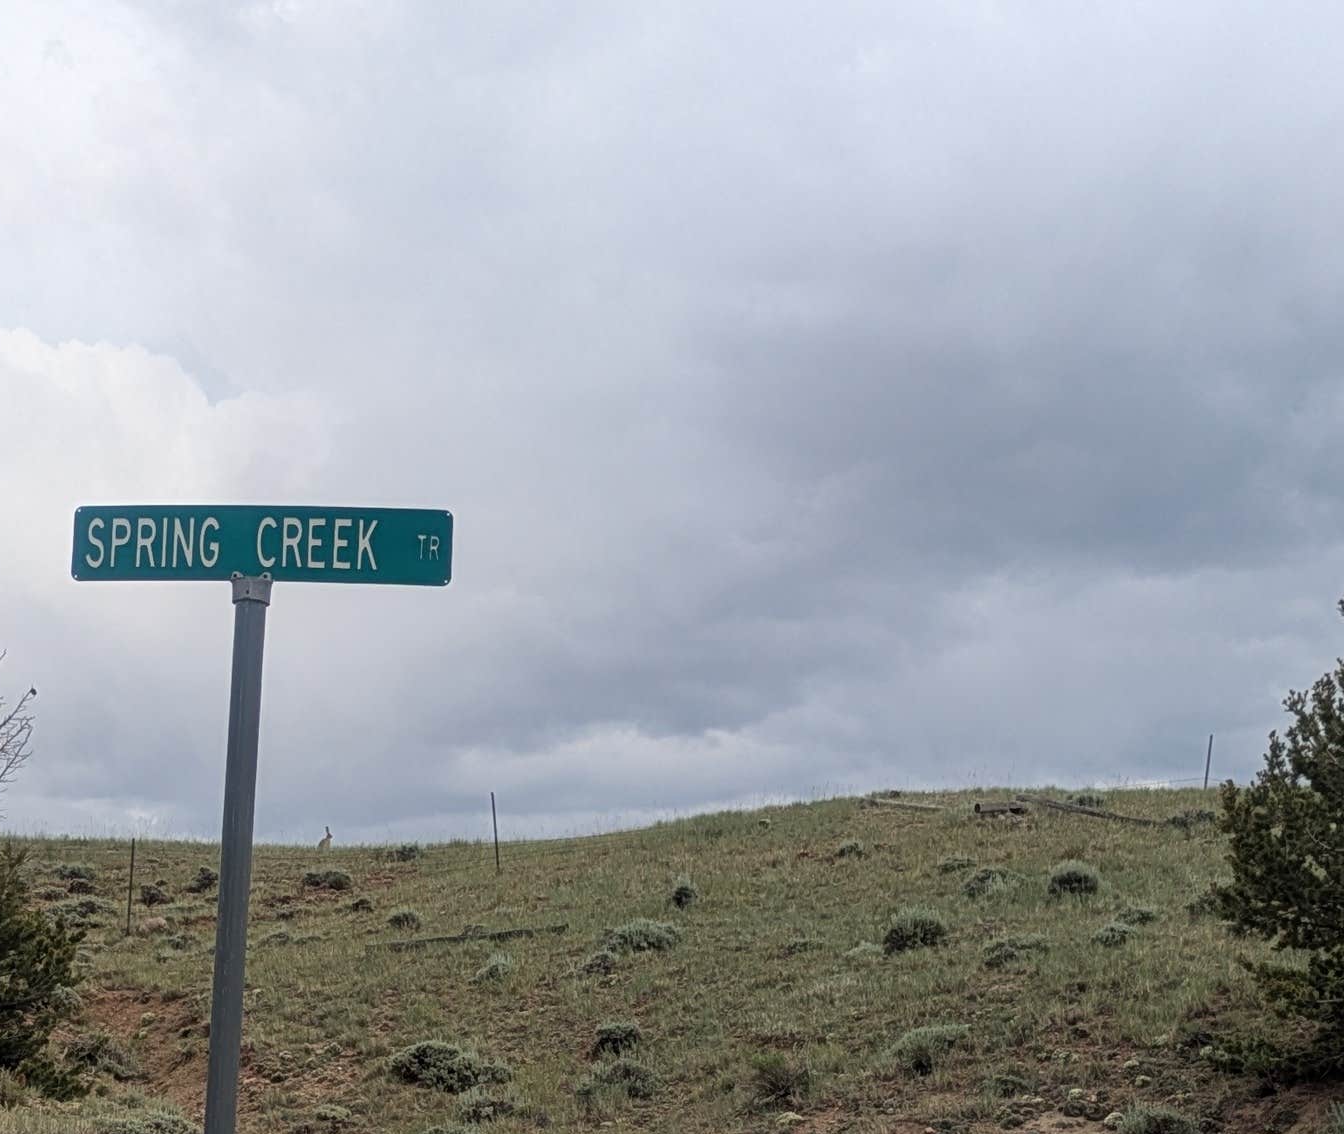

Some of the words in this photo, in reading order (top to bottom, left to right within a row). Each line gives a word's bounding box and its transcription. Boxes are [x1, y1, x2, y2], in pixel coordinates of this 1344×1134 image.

[85, 516, 220, 569] SPRING
[256, 516, 378, 570] CREEK
[417, 534, 440, 561] TR
